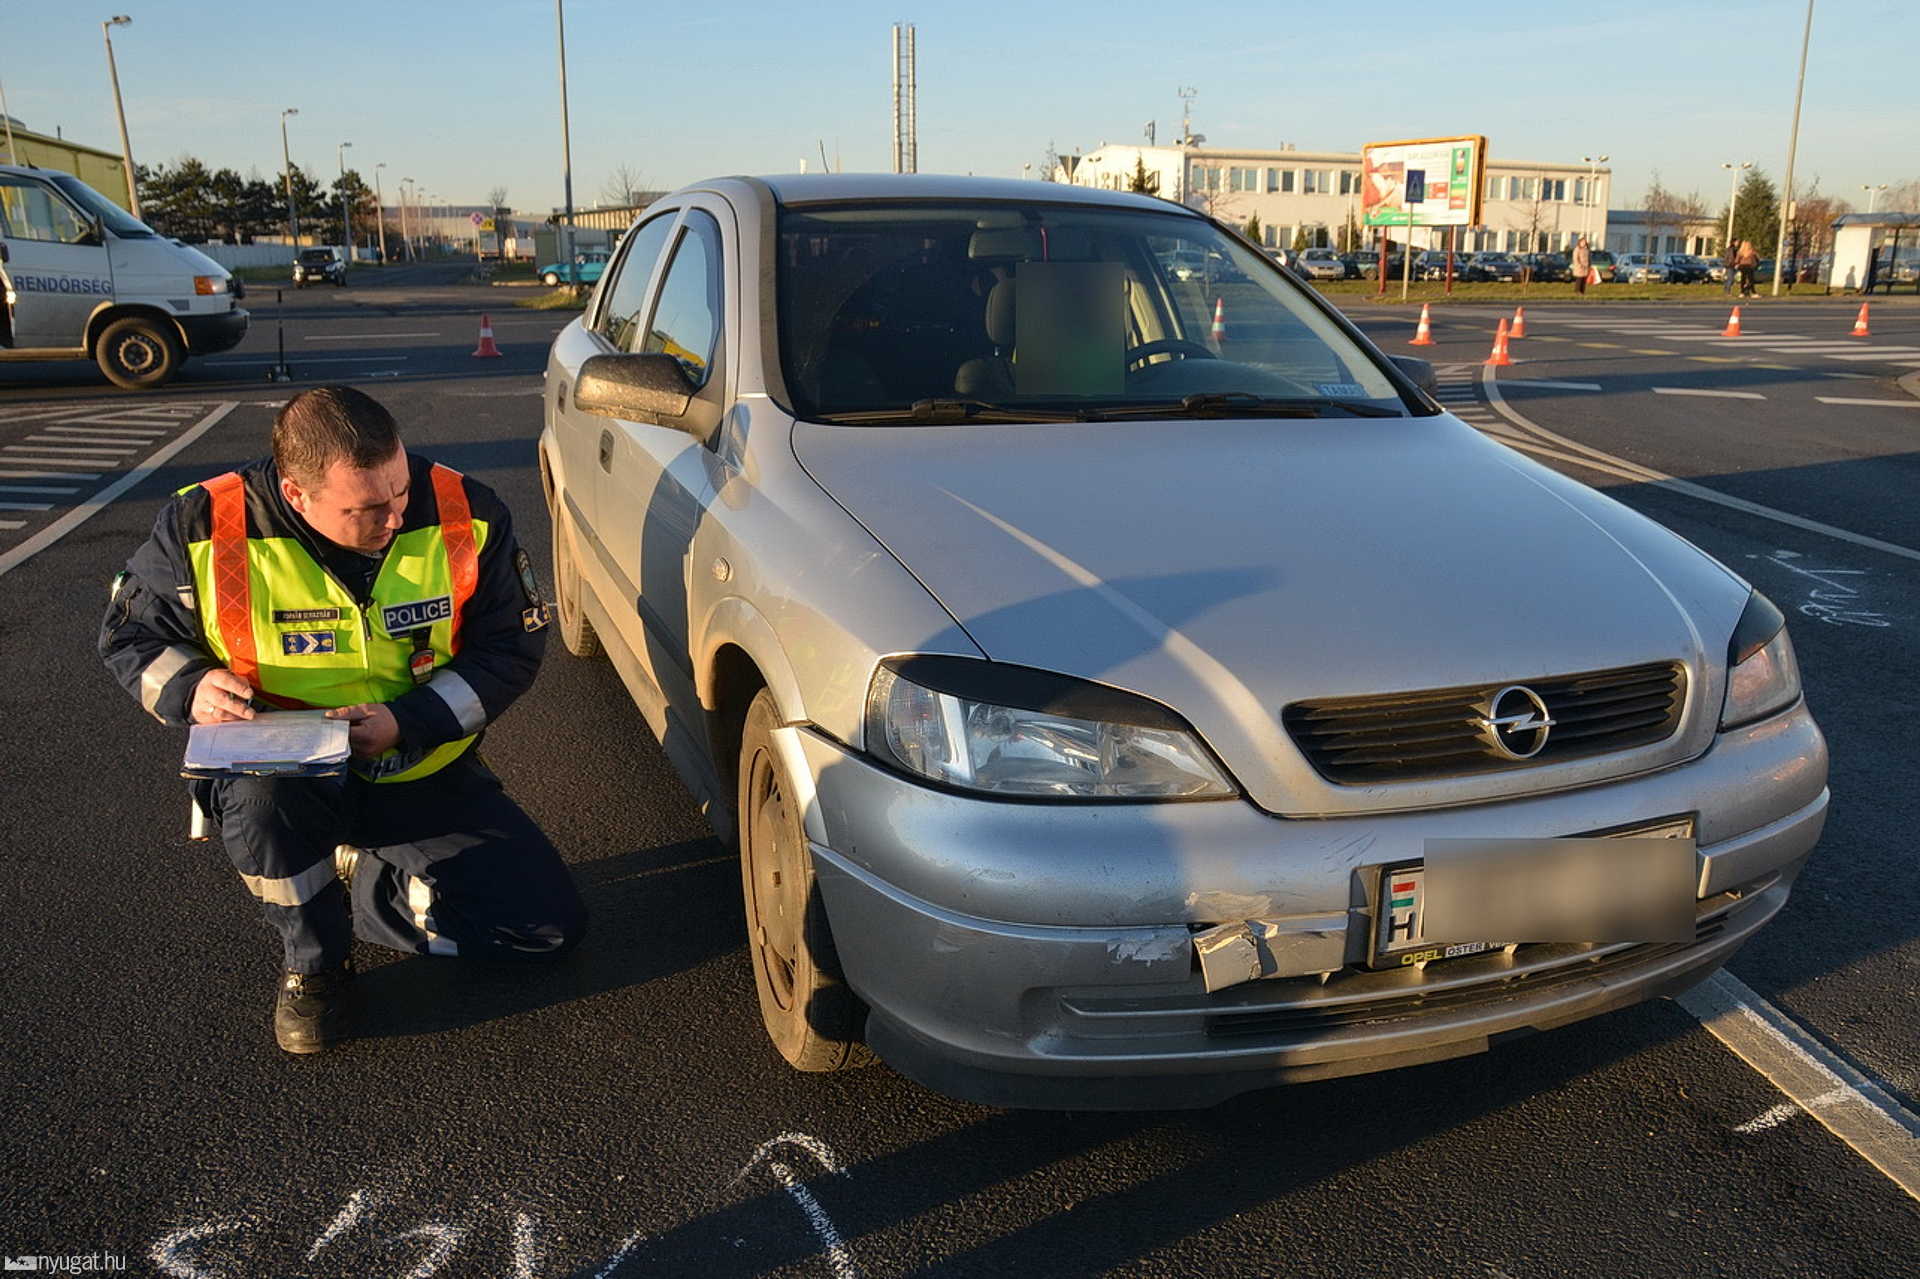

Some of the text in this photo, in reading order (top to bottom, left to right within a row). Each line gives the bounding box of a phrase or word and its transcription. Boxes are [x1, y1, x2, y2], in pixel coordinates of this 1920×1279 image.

[385, 600, 450, 627] POLICE
[1388, 911, 1416, 943] H
[1401, 949, 1443, 965] OPEL
